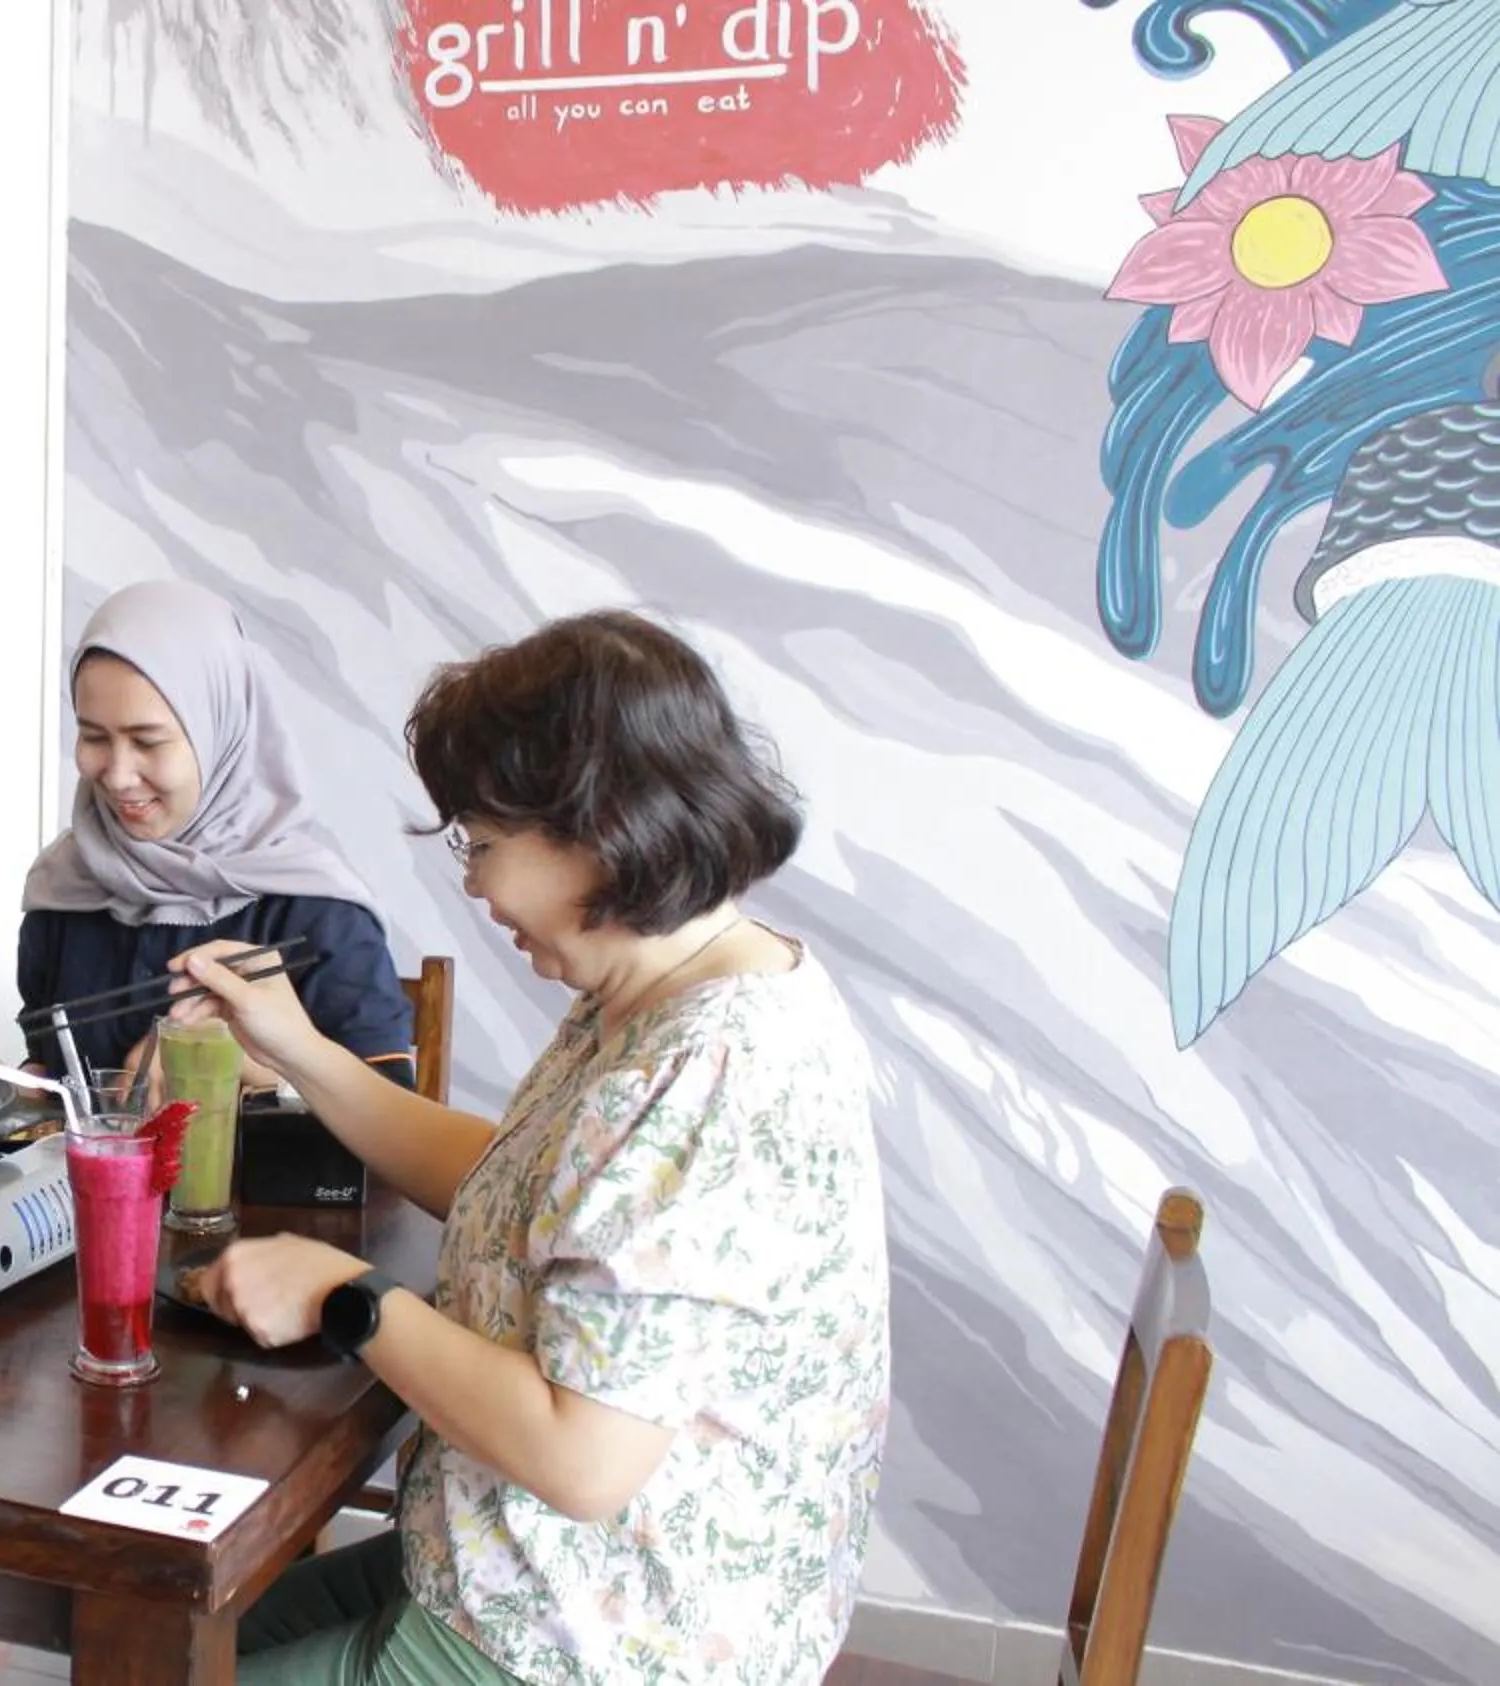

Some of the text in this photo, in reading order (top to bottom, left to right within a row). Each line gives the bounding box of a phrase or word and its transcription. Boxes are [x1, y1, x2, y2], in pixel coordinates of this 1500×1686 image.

[424, 0, 581, 108] grill
[721, 0, 861, 92] dip
[506, 84, 752, 135] all you can eat
[101, 1476, 223, 1516] 011
